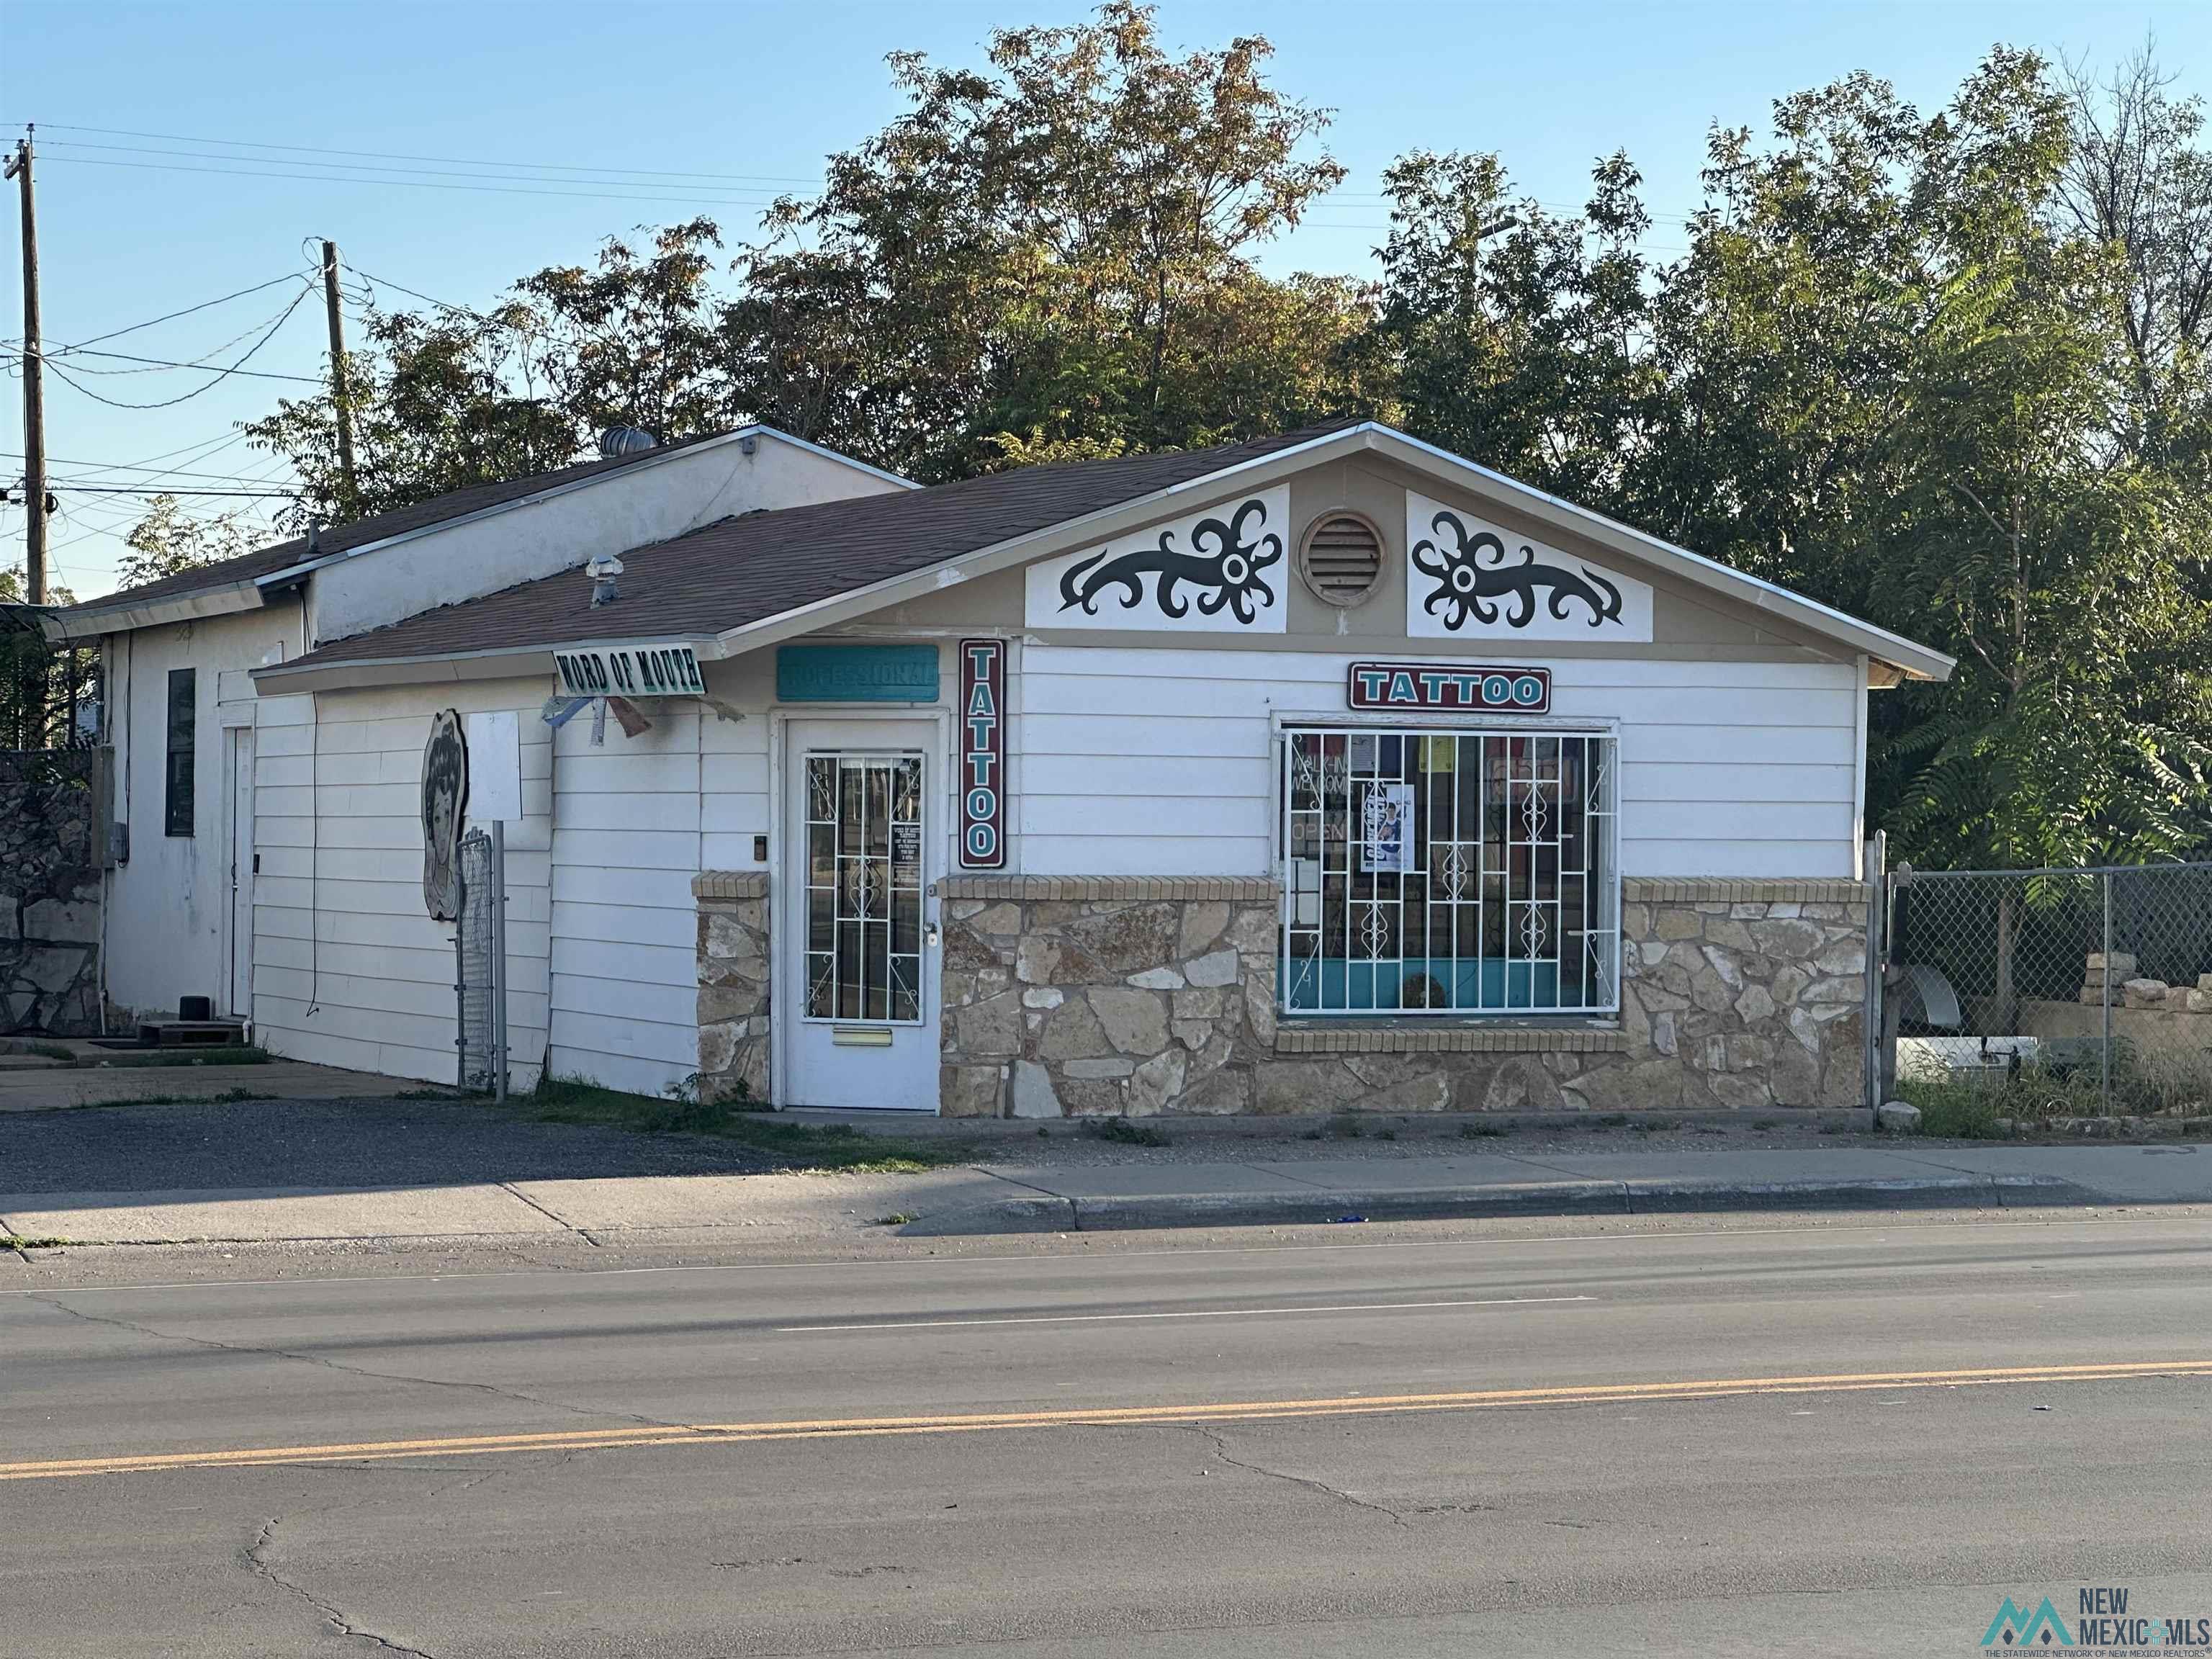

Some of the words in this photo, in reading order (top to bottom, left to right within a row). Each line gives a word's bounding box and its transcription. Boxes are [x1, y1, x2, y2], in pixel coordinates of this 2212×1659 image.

[557, 653, 610, 693] WORD
[610, 652, 637, 693] OF
[635, 647, 703, 693] MOUTH
[1357, 671, 1544, 706] TATTOO
[966, 647, 997, 858] TATTOO
